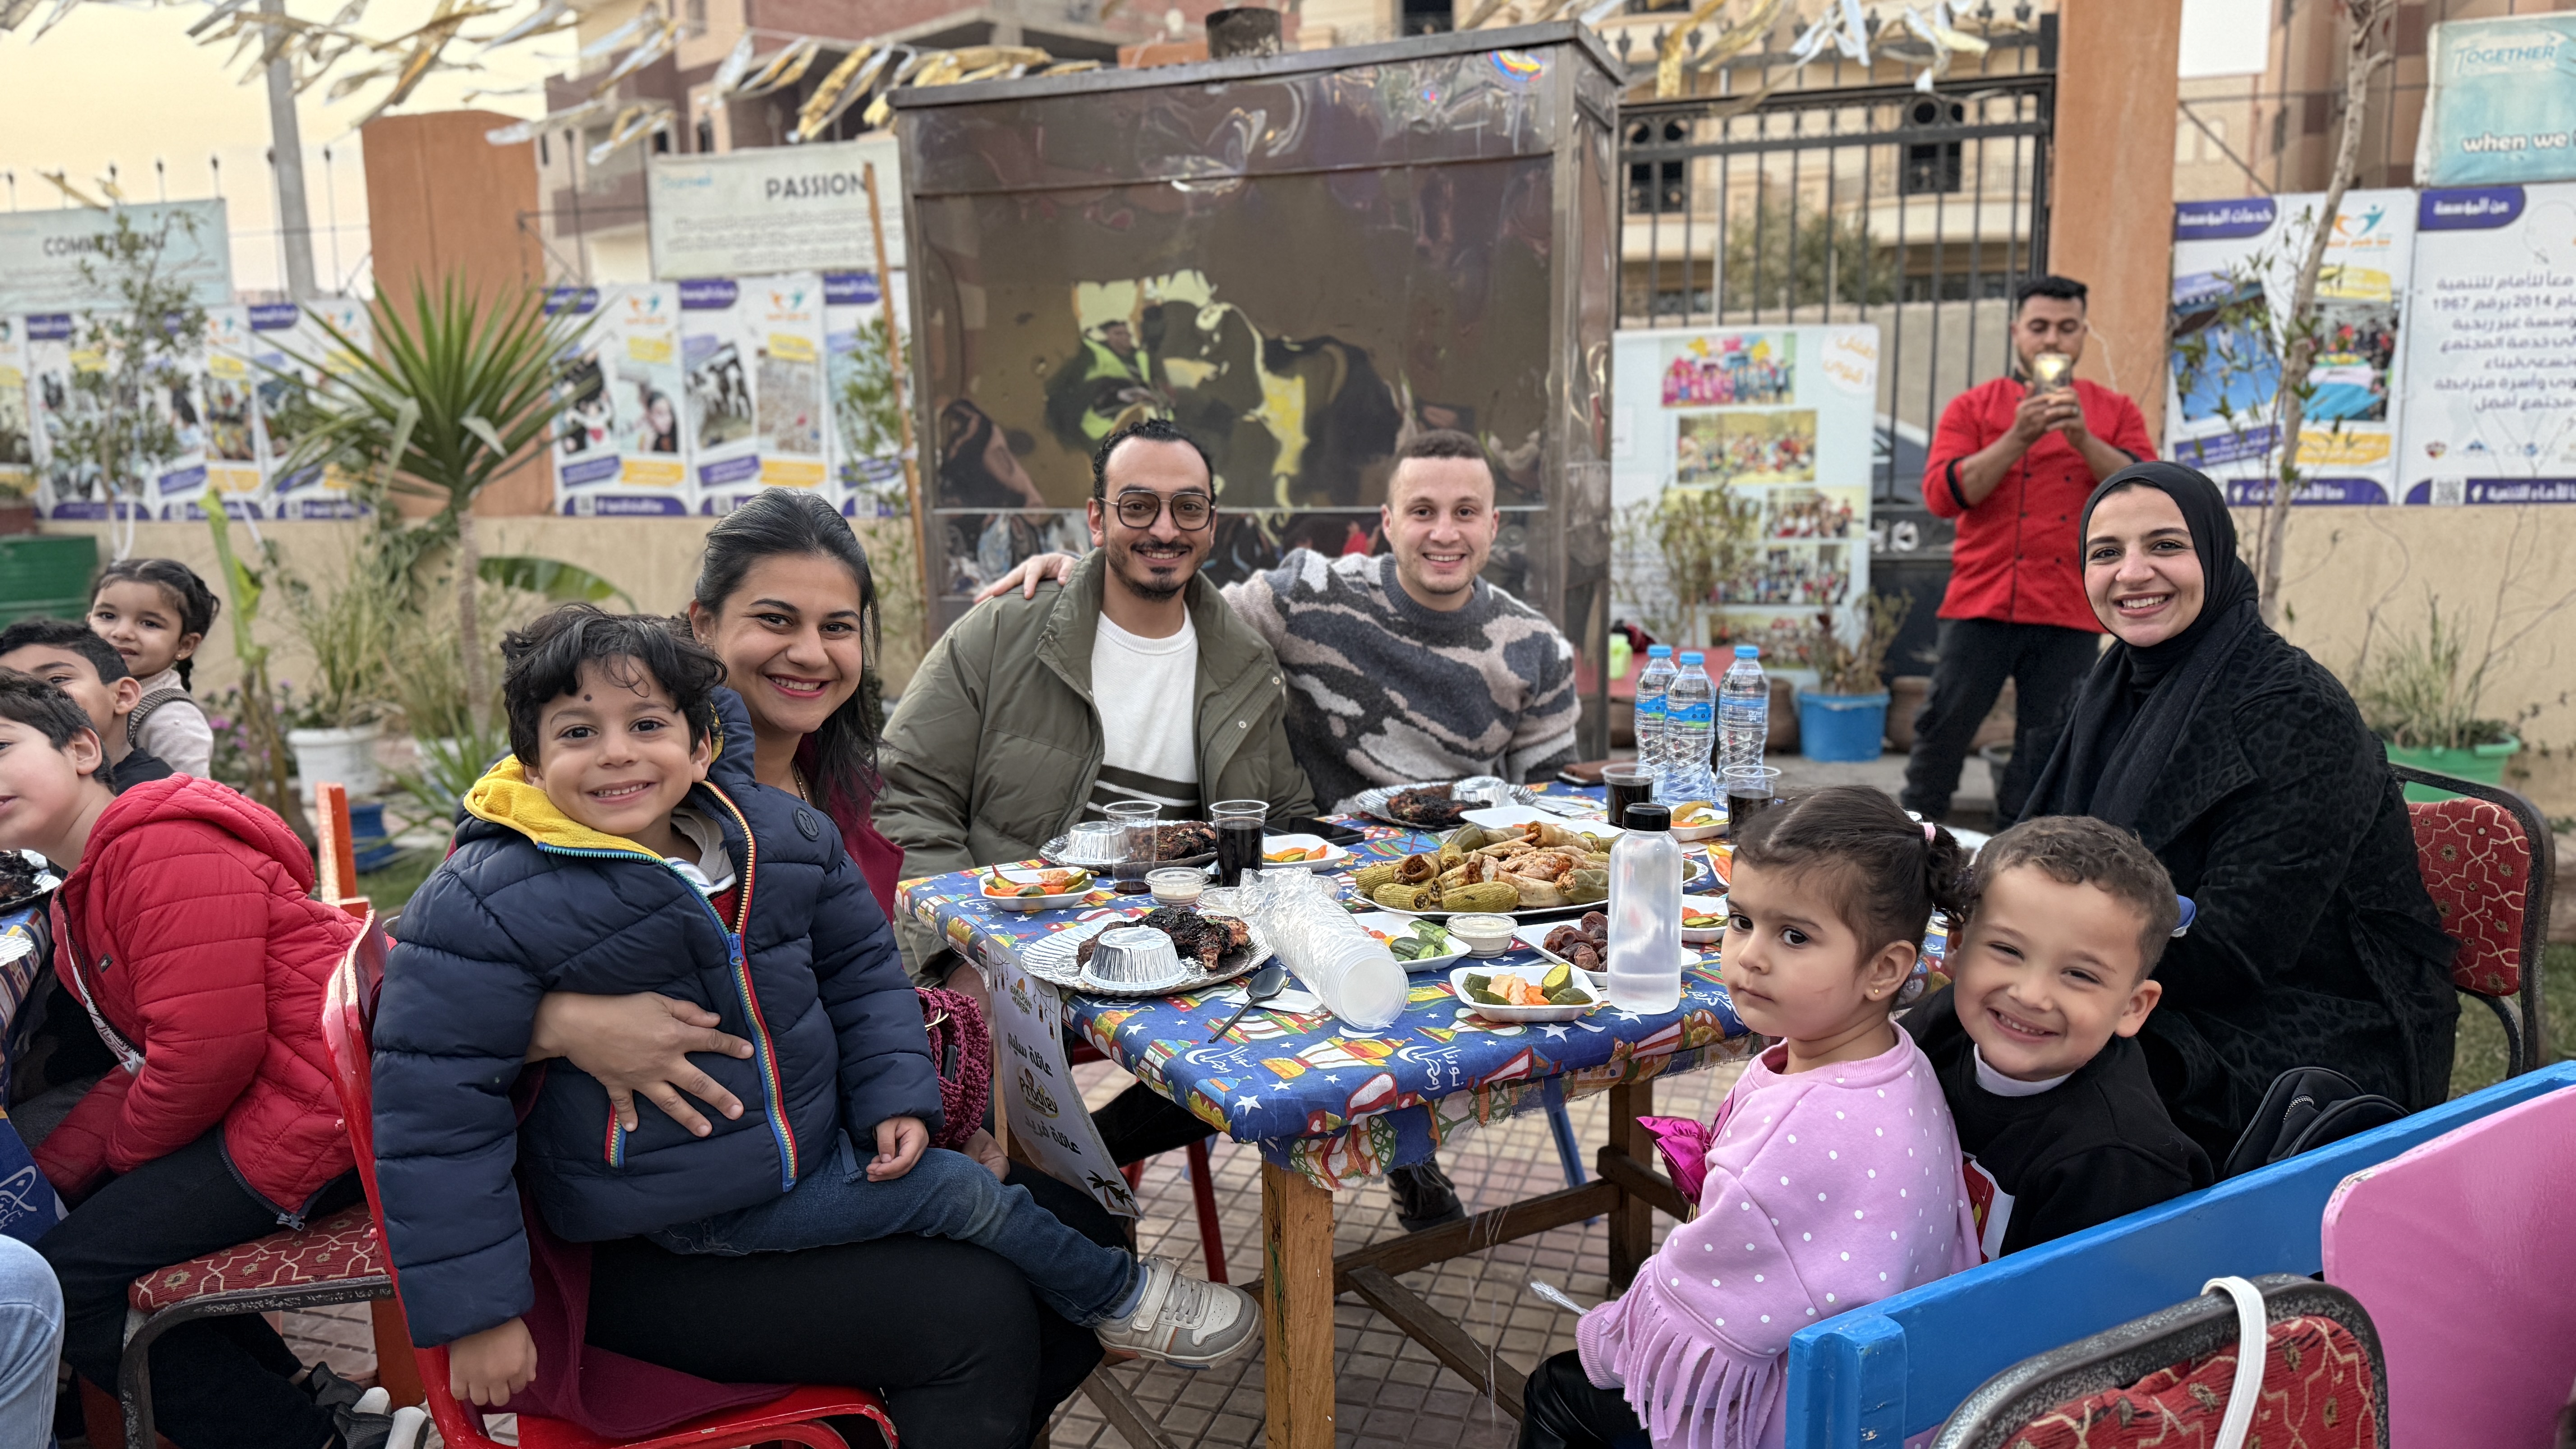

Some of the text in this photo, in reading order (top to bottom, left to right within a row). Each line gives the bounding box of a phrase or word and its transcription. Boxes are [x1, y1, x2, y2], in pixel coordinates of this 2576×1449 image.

[2455, 45, 2556, 74] TOGETHER
[2461, 132, 2527, 154] when
[2532, 133, 2568, 150] we
[765, 173, 867, 199] PASSION
[1008, 1032, 1053, 1078] عائلة سليم
[1019, 1076, 1058, 1114] Prodigy
[1049, 1125, 1082, 1155] عائلة
